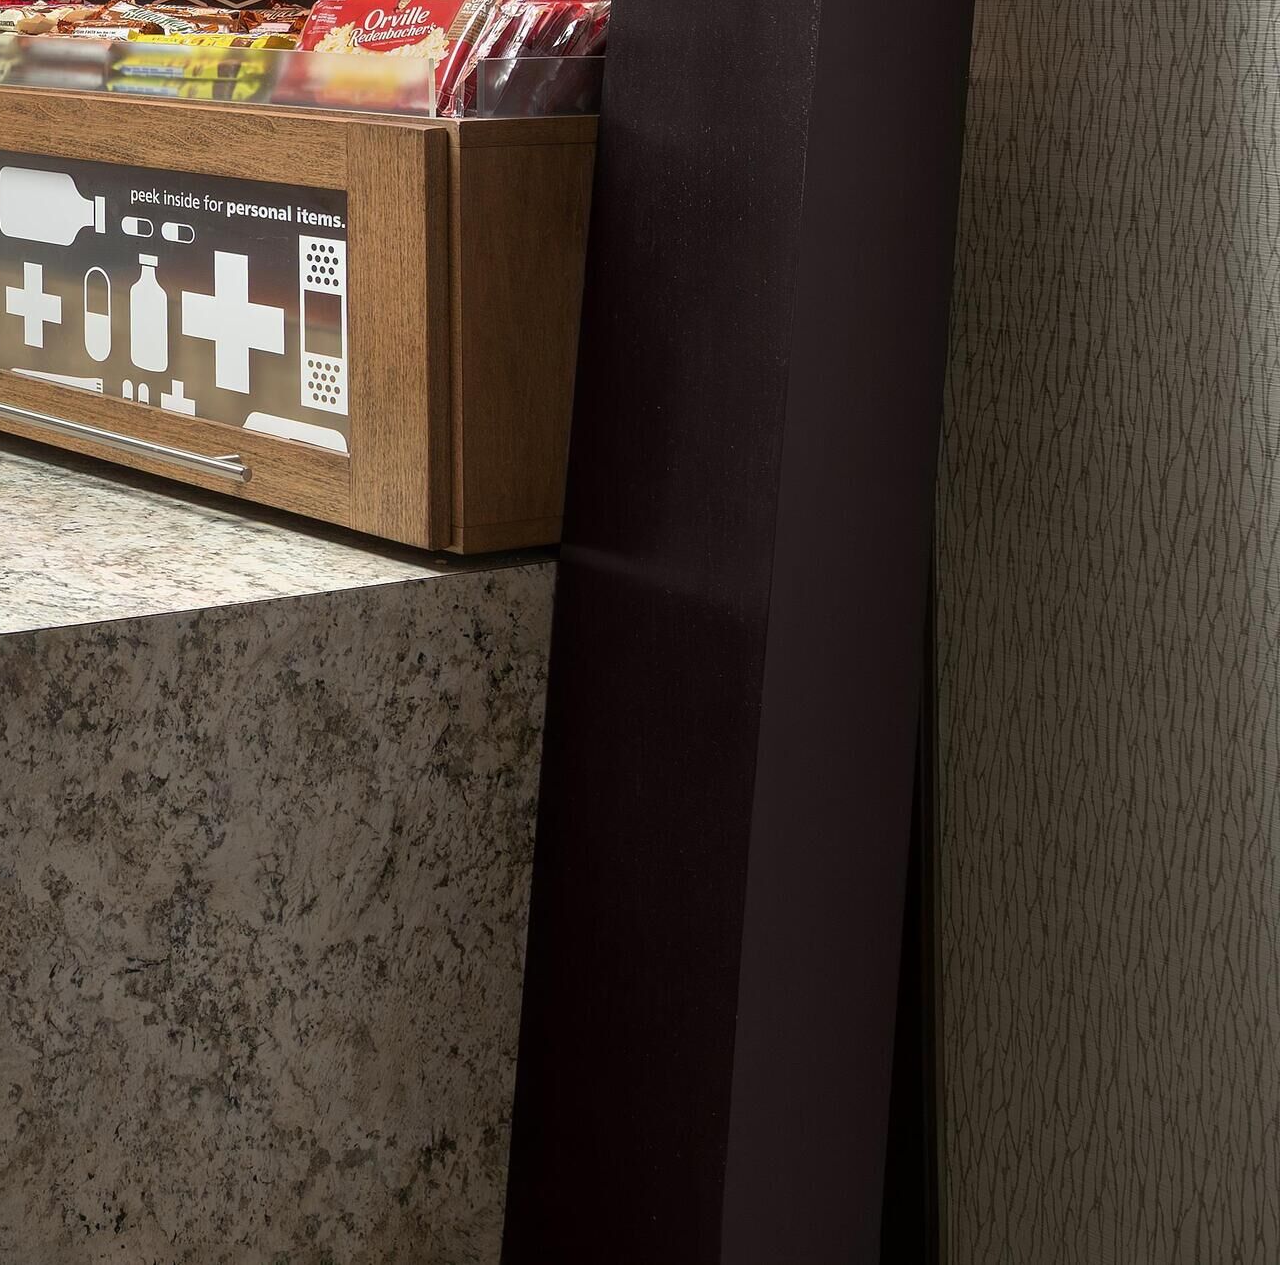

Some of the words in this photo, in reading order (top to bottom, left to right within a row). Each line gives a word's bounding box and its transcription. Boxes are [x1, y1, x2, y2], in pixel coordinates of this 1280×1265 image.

[364, 6, 431, 31] Orville
[463, 2, 489, 14] REA
[347, 21, 437, 47] Redenbacher's
[130, 188, 160, 208] peek
[163, 191, 200, 209] inside
[203, 194, 223, 212] for
[226, 200, 292, 223] personal
[296, 207, 346, 229] items.
